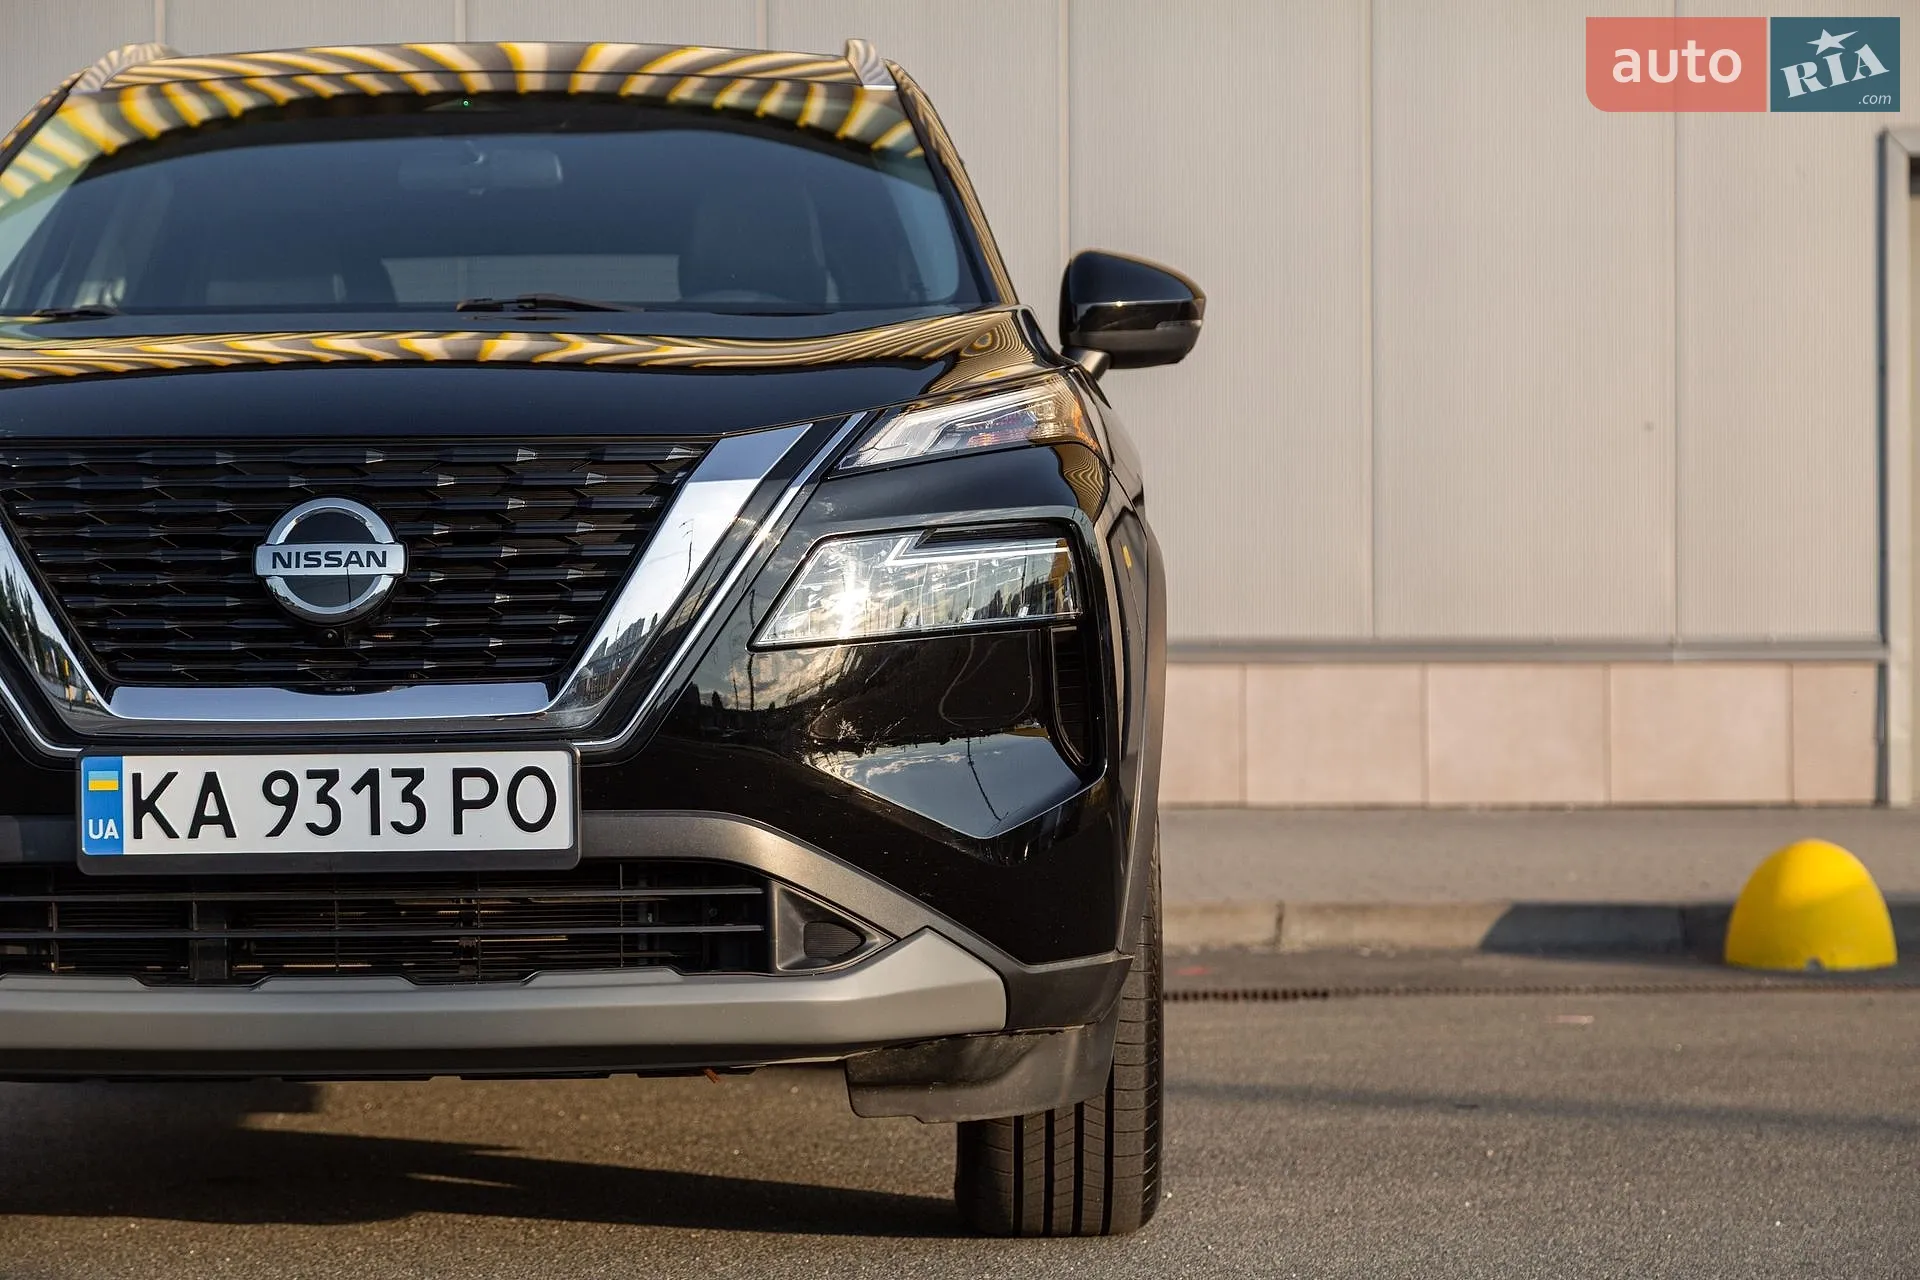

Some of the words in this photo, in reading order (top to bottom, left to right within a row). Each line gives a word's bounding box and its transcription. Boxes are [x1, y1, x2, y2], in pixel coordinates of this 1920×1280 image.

[272, 550, 387, 569] NISSAN
[131, 771, 237, 840] KA
[261, 767, 426, 837] 9313
[452, 765, 558, 835] PO
[88, 818, 119, 840] UA
